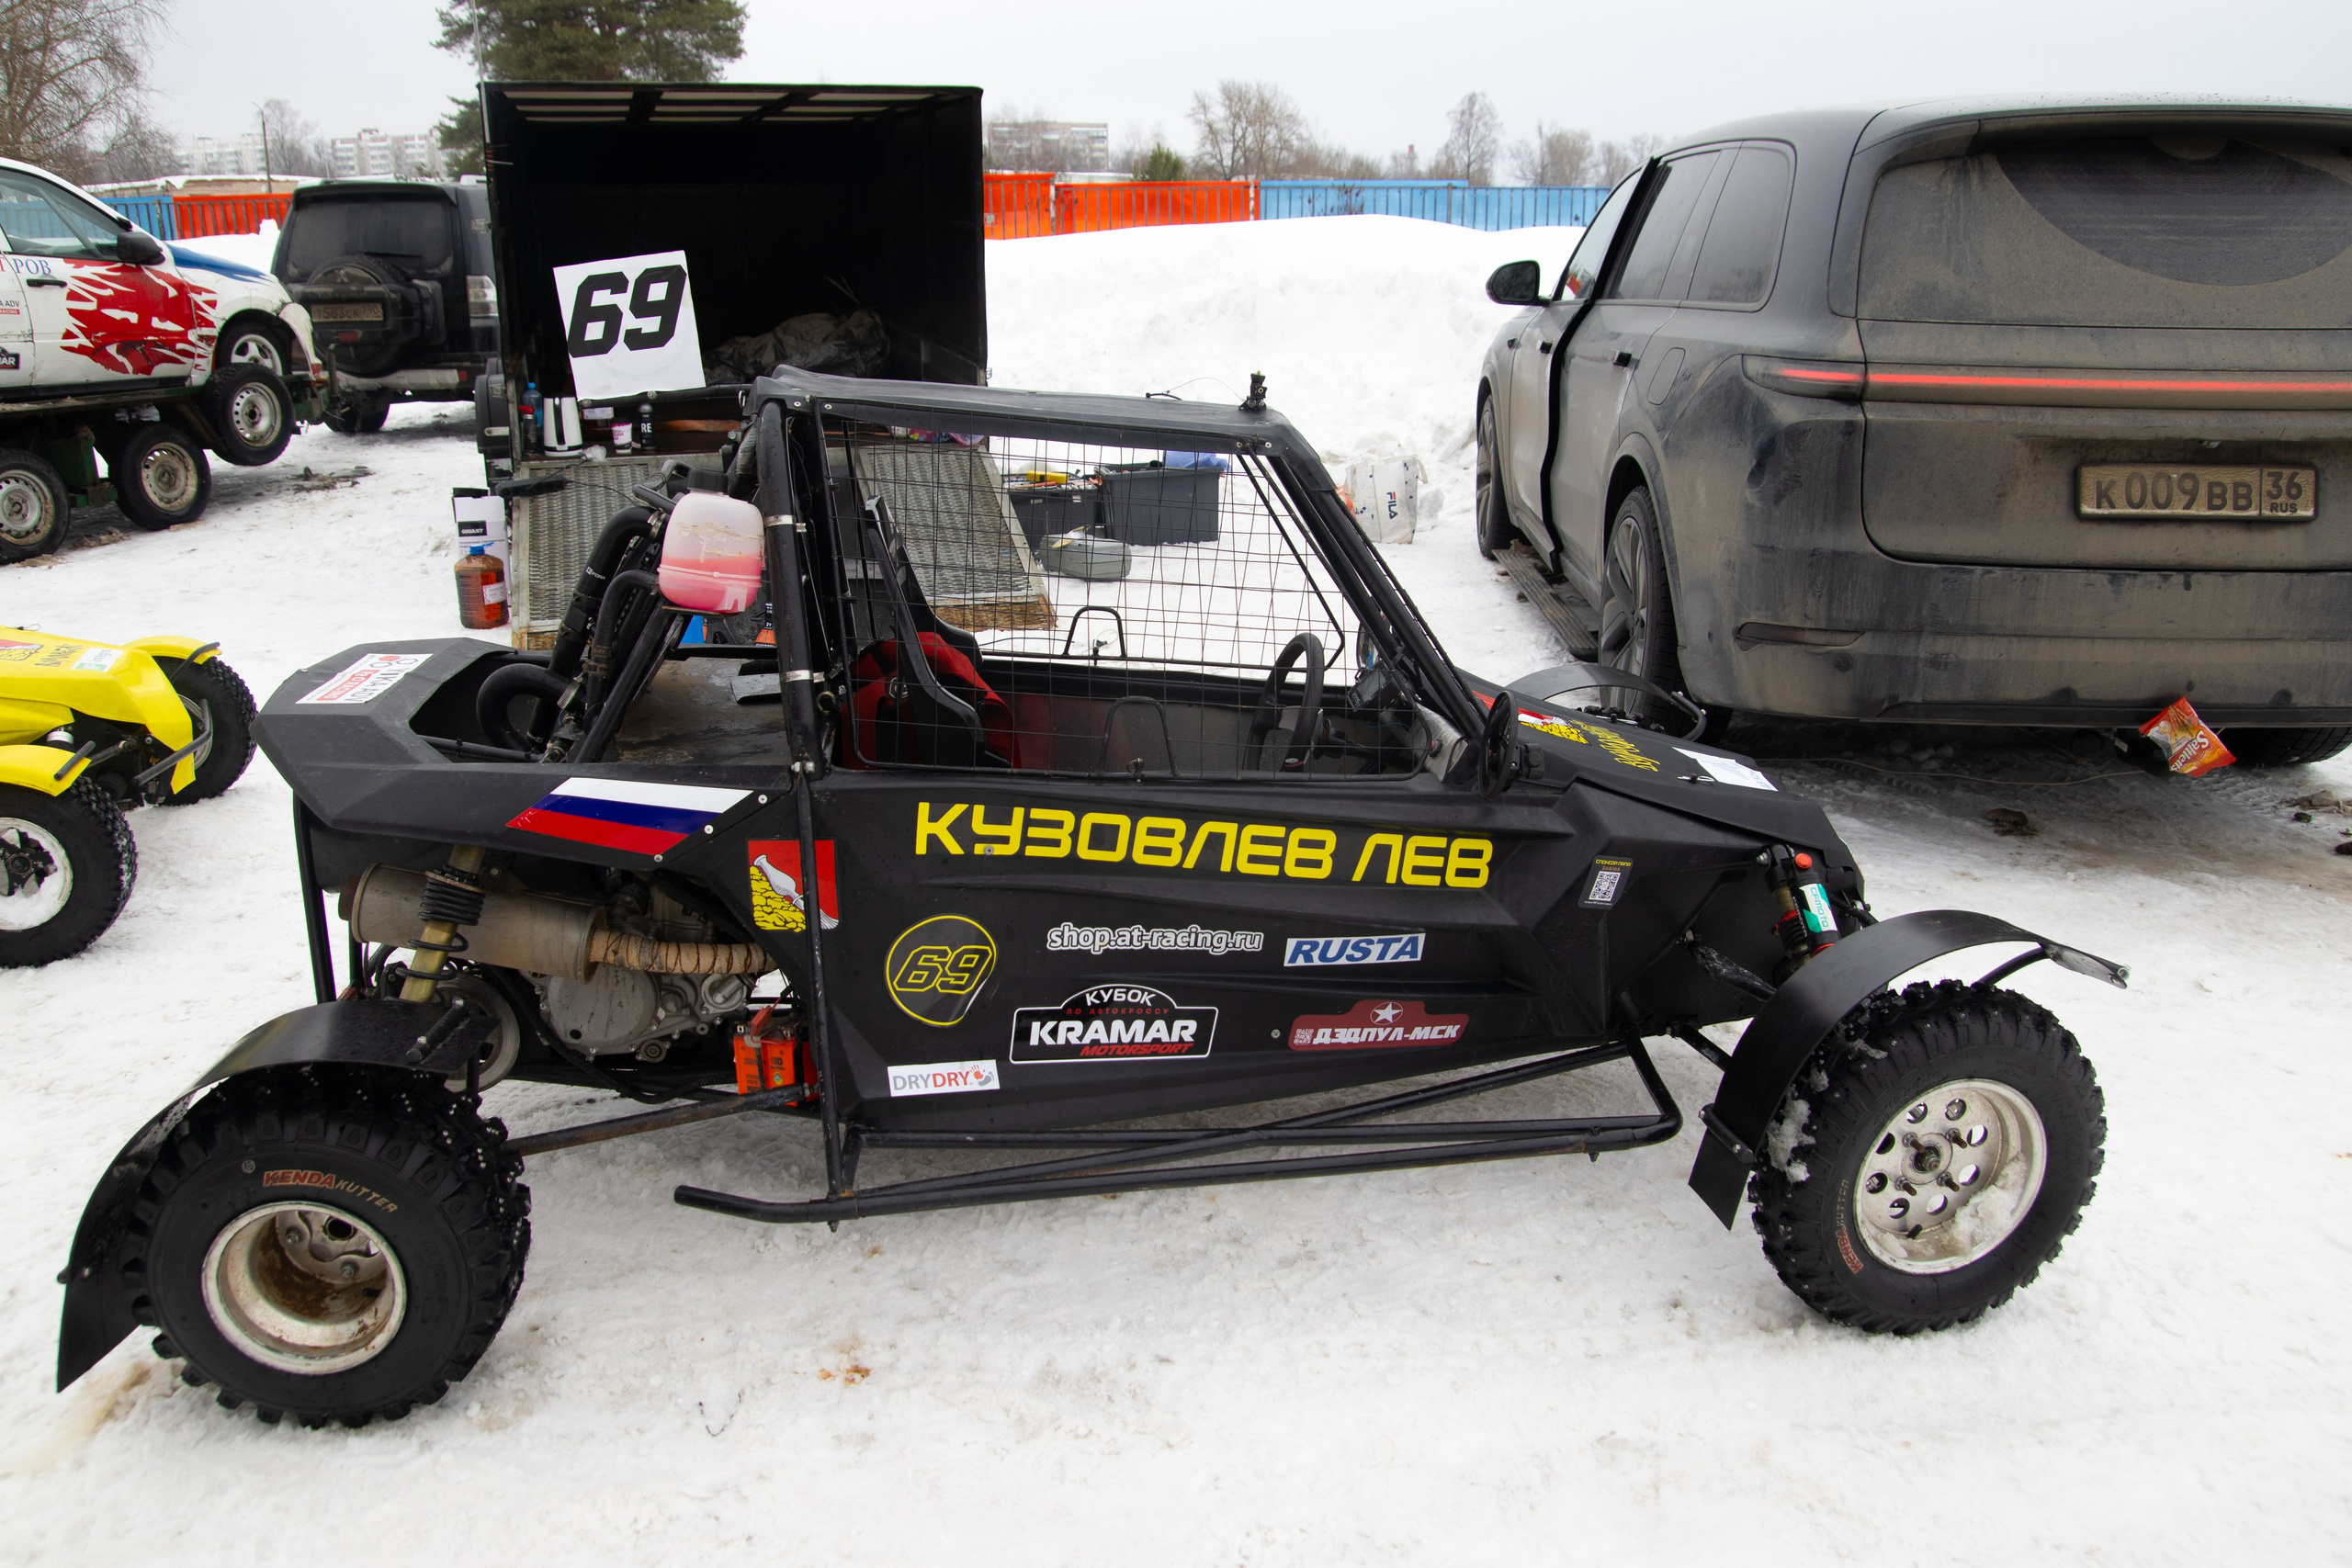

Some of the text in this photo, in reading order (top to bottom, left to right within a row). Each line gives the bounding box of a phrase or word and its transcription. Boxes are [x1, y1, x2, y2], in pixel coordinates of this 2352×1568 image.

[567, 265, 687, 358] 69
[1386, 491, 1398, 519] FILA
[2095, 471, 2302, 511] К009ВВ 36
[2270, 502, 2298, 513] RUS
[2171, 729, 2210, 772] Saltletts
[916, 802, 1493, 888] КУЗОВЛЕВ ЛЕВ
[1810, 886, 1829, 928] CFMOTO
[1047, 922, 1263, 953] shop.at-racing.ru
[1287, 935, 1420, 964] RUSTA
[893, 945, 992, 994] 69
[1085, 988, 1156, 1007] КУБОК
[1029, 1020, 1197, 1045] KRAMAR
[1080, 1043, 1193, 1056] MOTORSPORT
[892, 1070, 970, 1091] DRYDRY
[263, 1169, 398, 1213] KENDA KUTTER
[1836, 1225, 1864, 1274] KENDA
